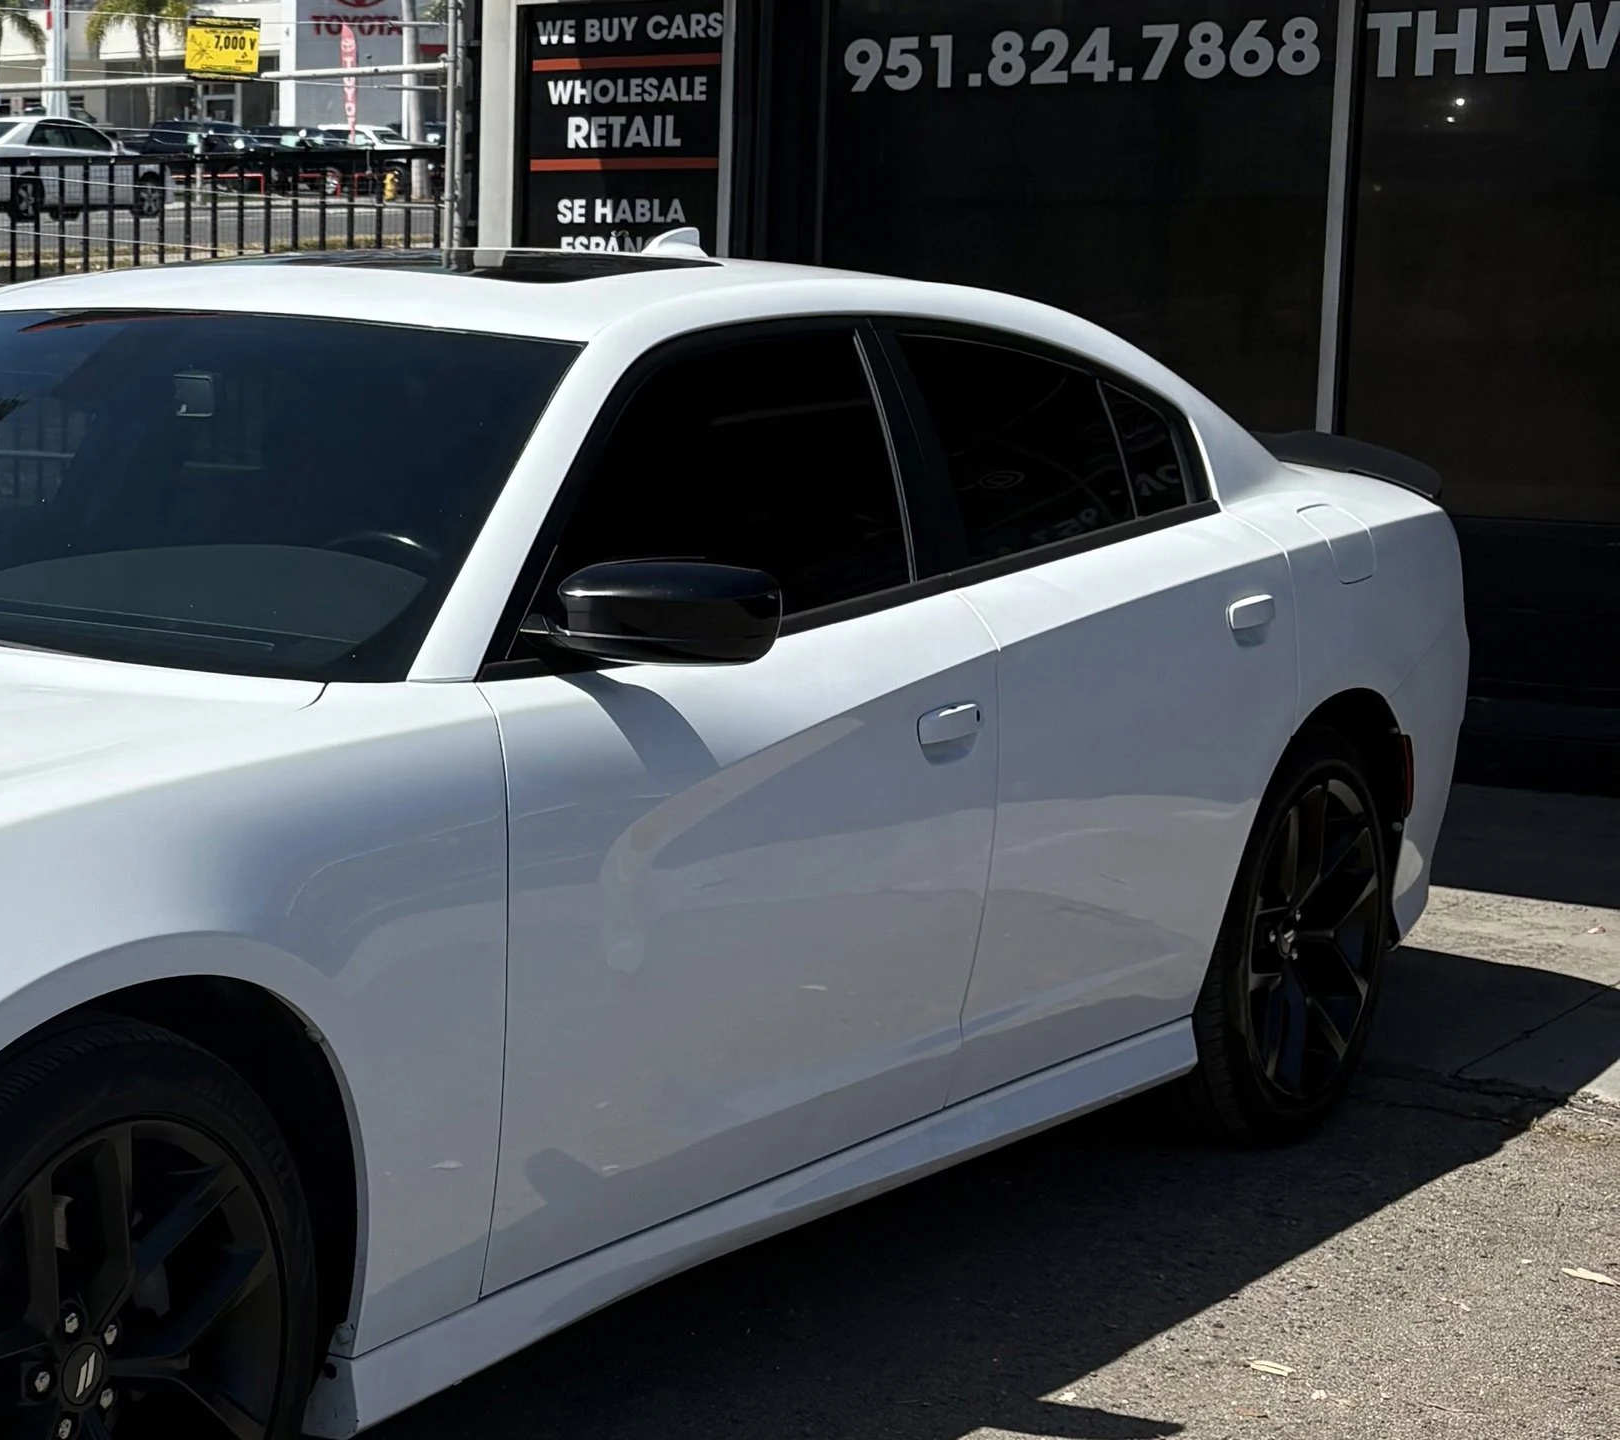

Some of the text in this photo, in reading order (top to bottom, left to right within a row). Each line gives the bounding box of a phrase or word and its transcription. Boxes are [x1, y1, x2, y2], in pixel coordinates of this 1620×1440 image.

[214, 35, 257, 51] 7,000 V
[536, 12, 724, 45] WE BUY CARS
[844, 16, 1320, 92] 951.824.7868
[548, 76, 708, 105] WHOLESALE
[567, 115, 681, 148] RETAIL
[557, 198, 686, 224] SE HABLA
